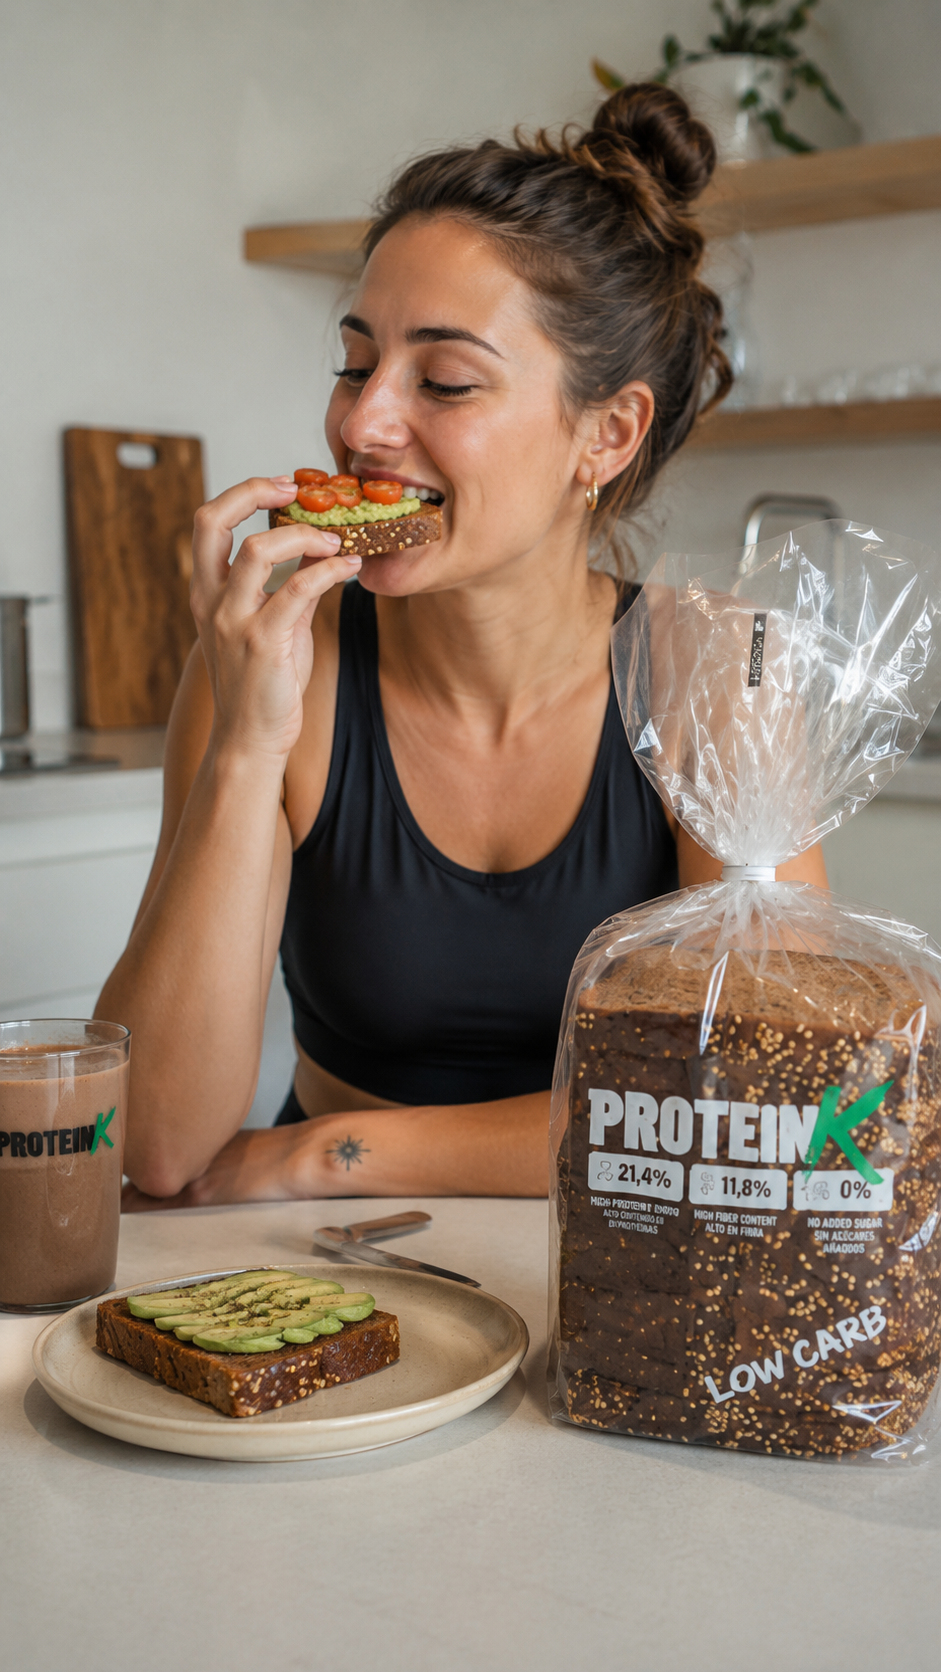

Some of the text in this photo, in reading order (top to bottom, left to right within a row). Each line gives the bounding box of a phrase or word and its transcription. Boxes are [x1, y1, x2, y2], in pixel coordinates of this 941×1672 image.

[618, 1162, 671, 1188] 21,4%
[721, 1175, 771, 1198] 11,8%
[840, 1179, 871, 1199] 0%
[694, 1209, 713, 1220] HIGH
[740, 1214, 777, 1226] CONTENT
[807, 1217, 883, 1229] NO ADDED SUGAR
[705, 1223, 725, 1234] ALTO
[727, 1225, 738, 1235] EN
[814, 1230, 829, 1241] SIN
[704, 1305, 886, 1403] LOW CARB
